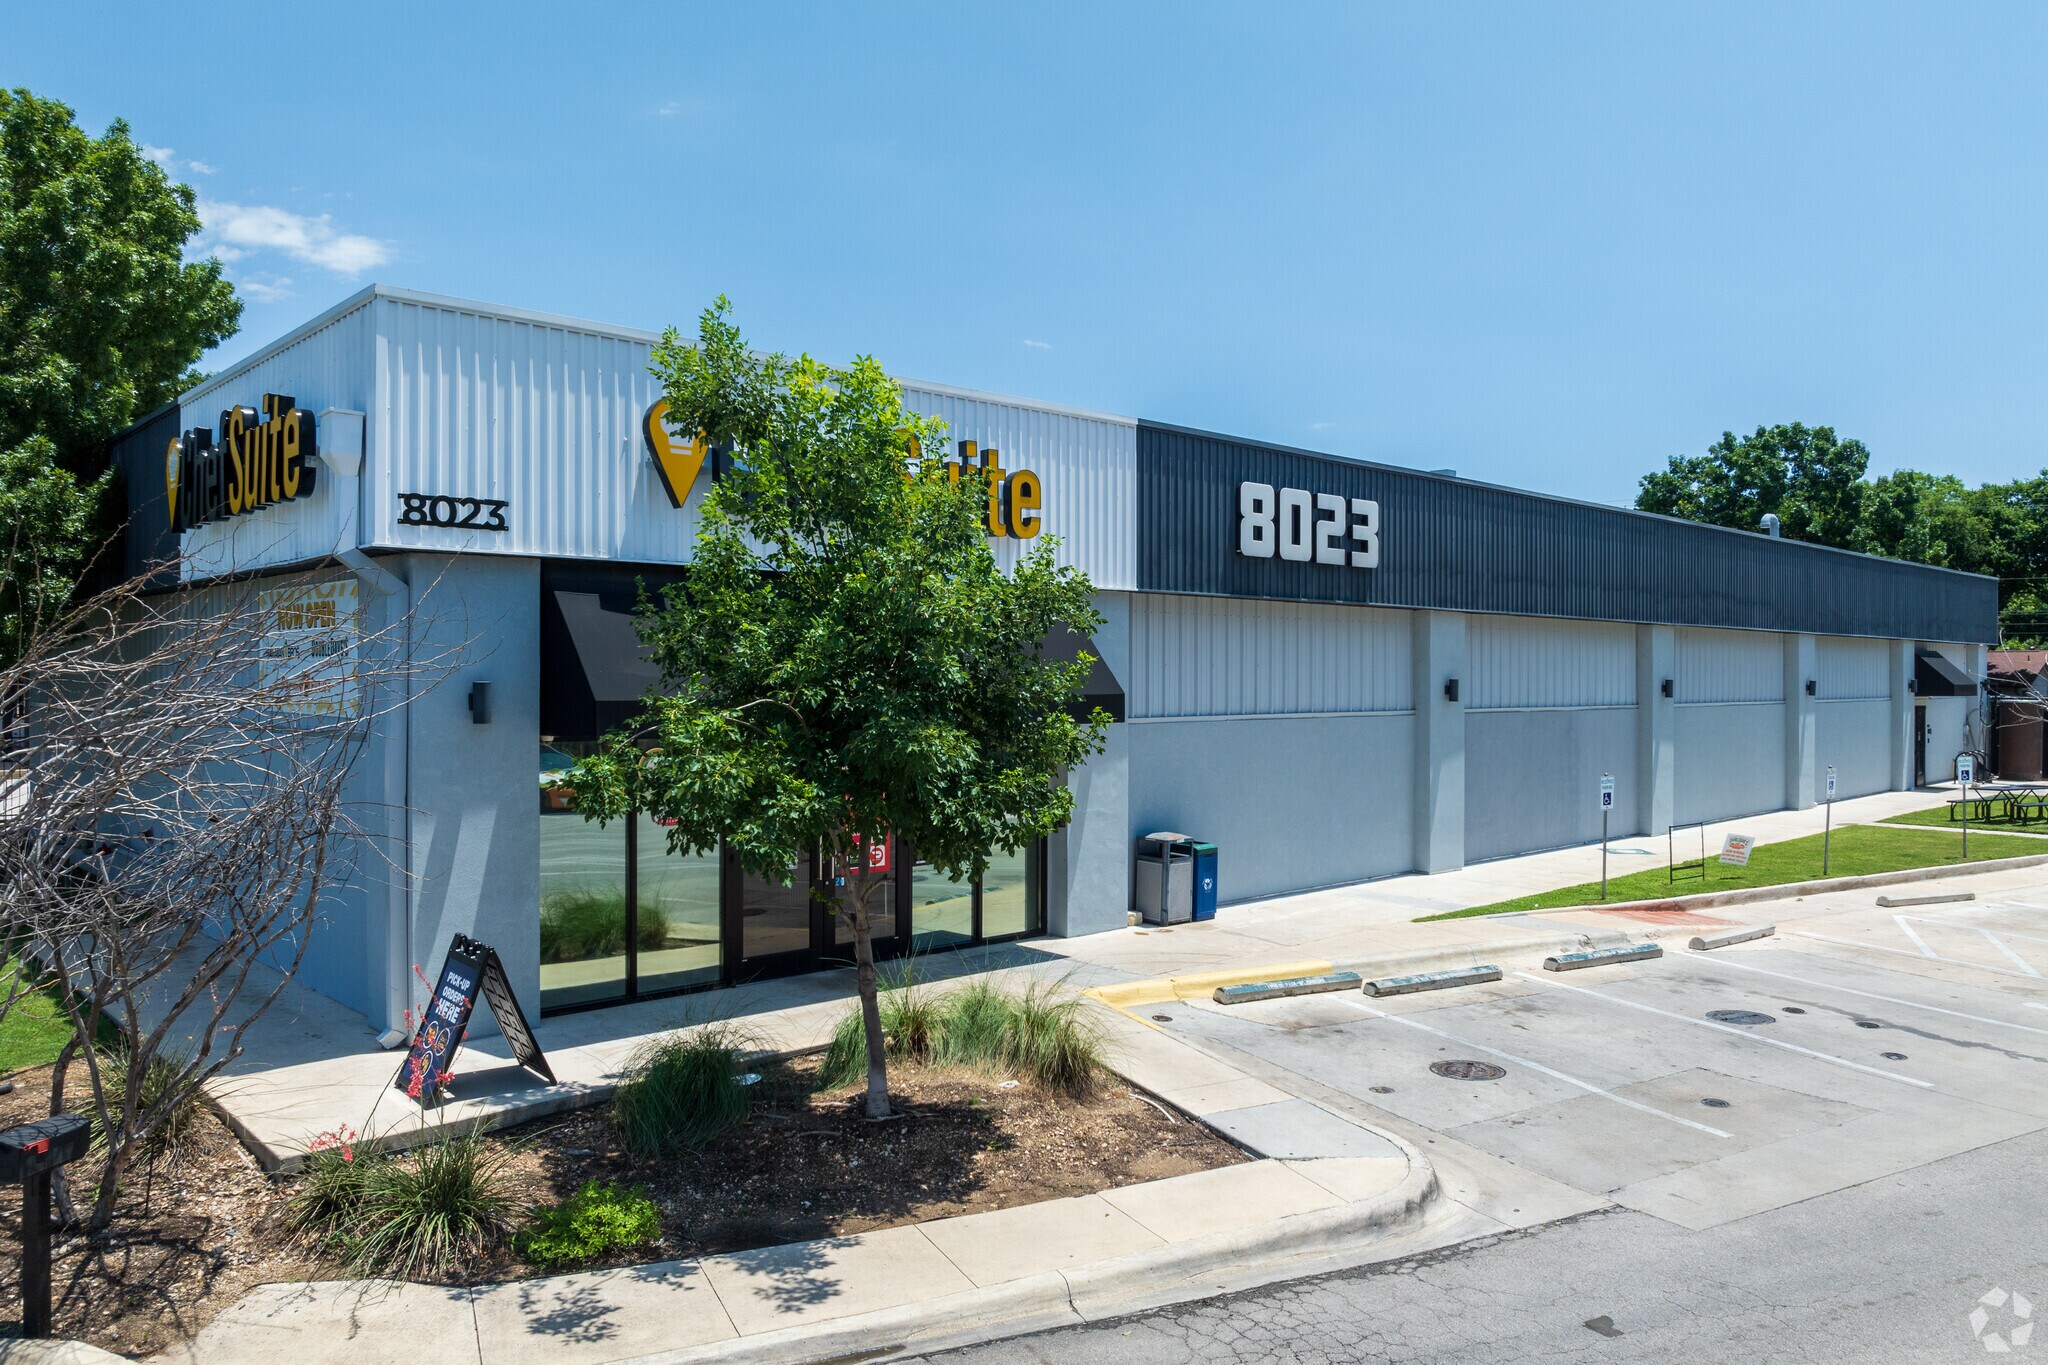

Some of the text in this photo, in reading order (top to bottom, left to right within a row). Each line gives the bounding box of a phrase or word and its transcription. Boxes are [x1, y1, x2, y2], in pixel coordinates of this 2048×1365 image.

[229, 393, 304, 515] Suite
[402, 493, 506, 531] 8023
[1240, 481, 1379, 569] 8023
[278, 600, 335, 630] NOW OPEN
[442, 985, 465, 1006] ORDERS
[446, 971, 471, 991] PICK-UP
[435, 997, 461, 1024] HERE
